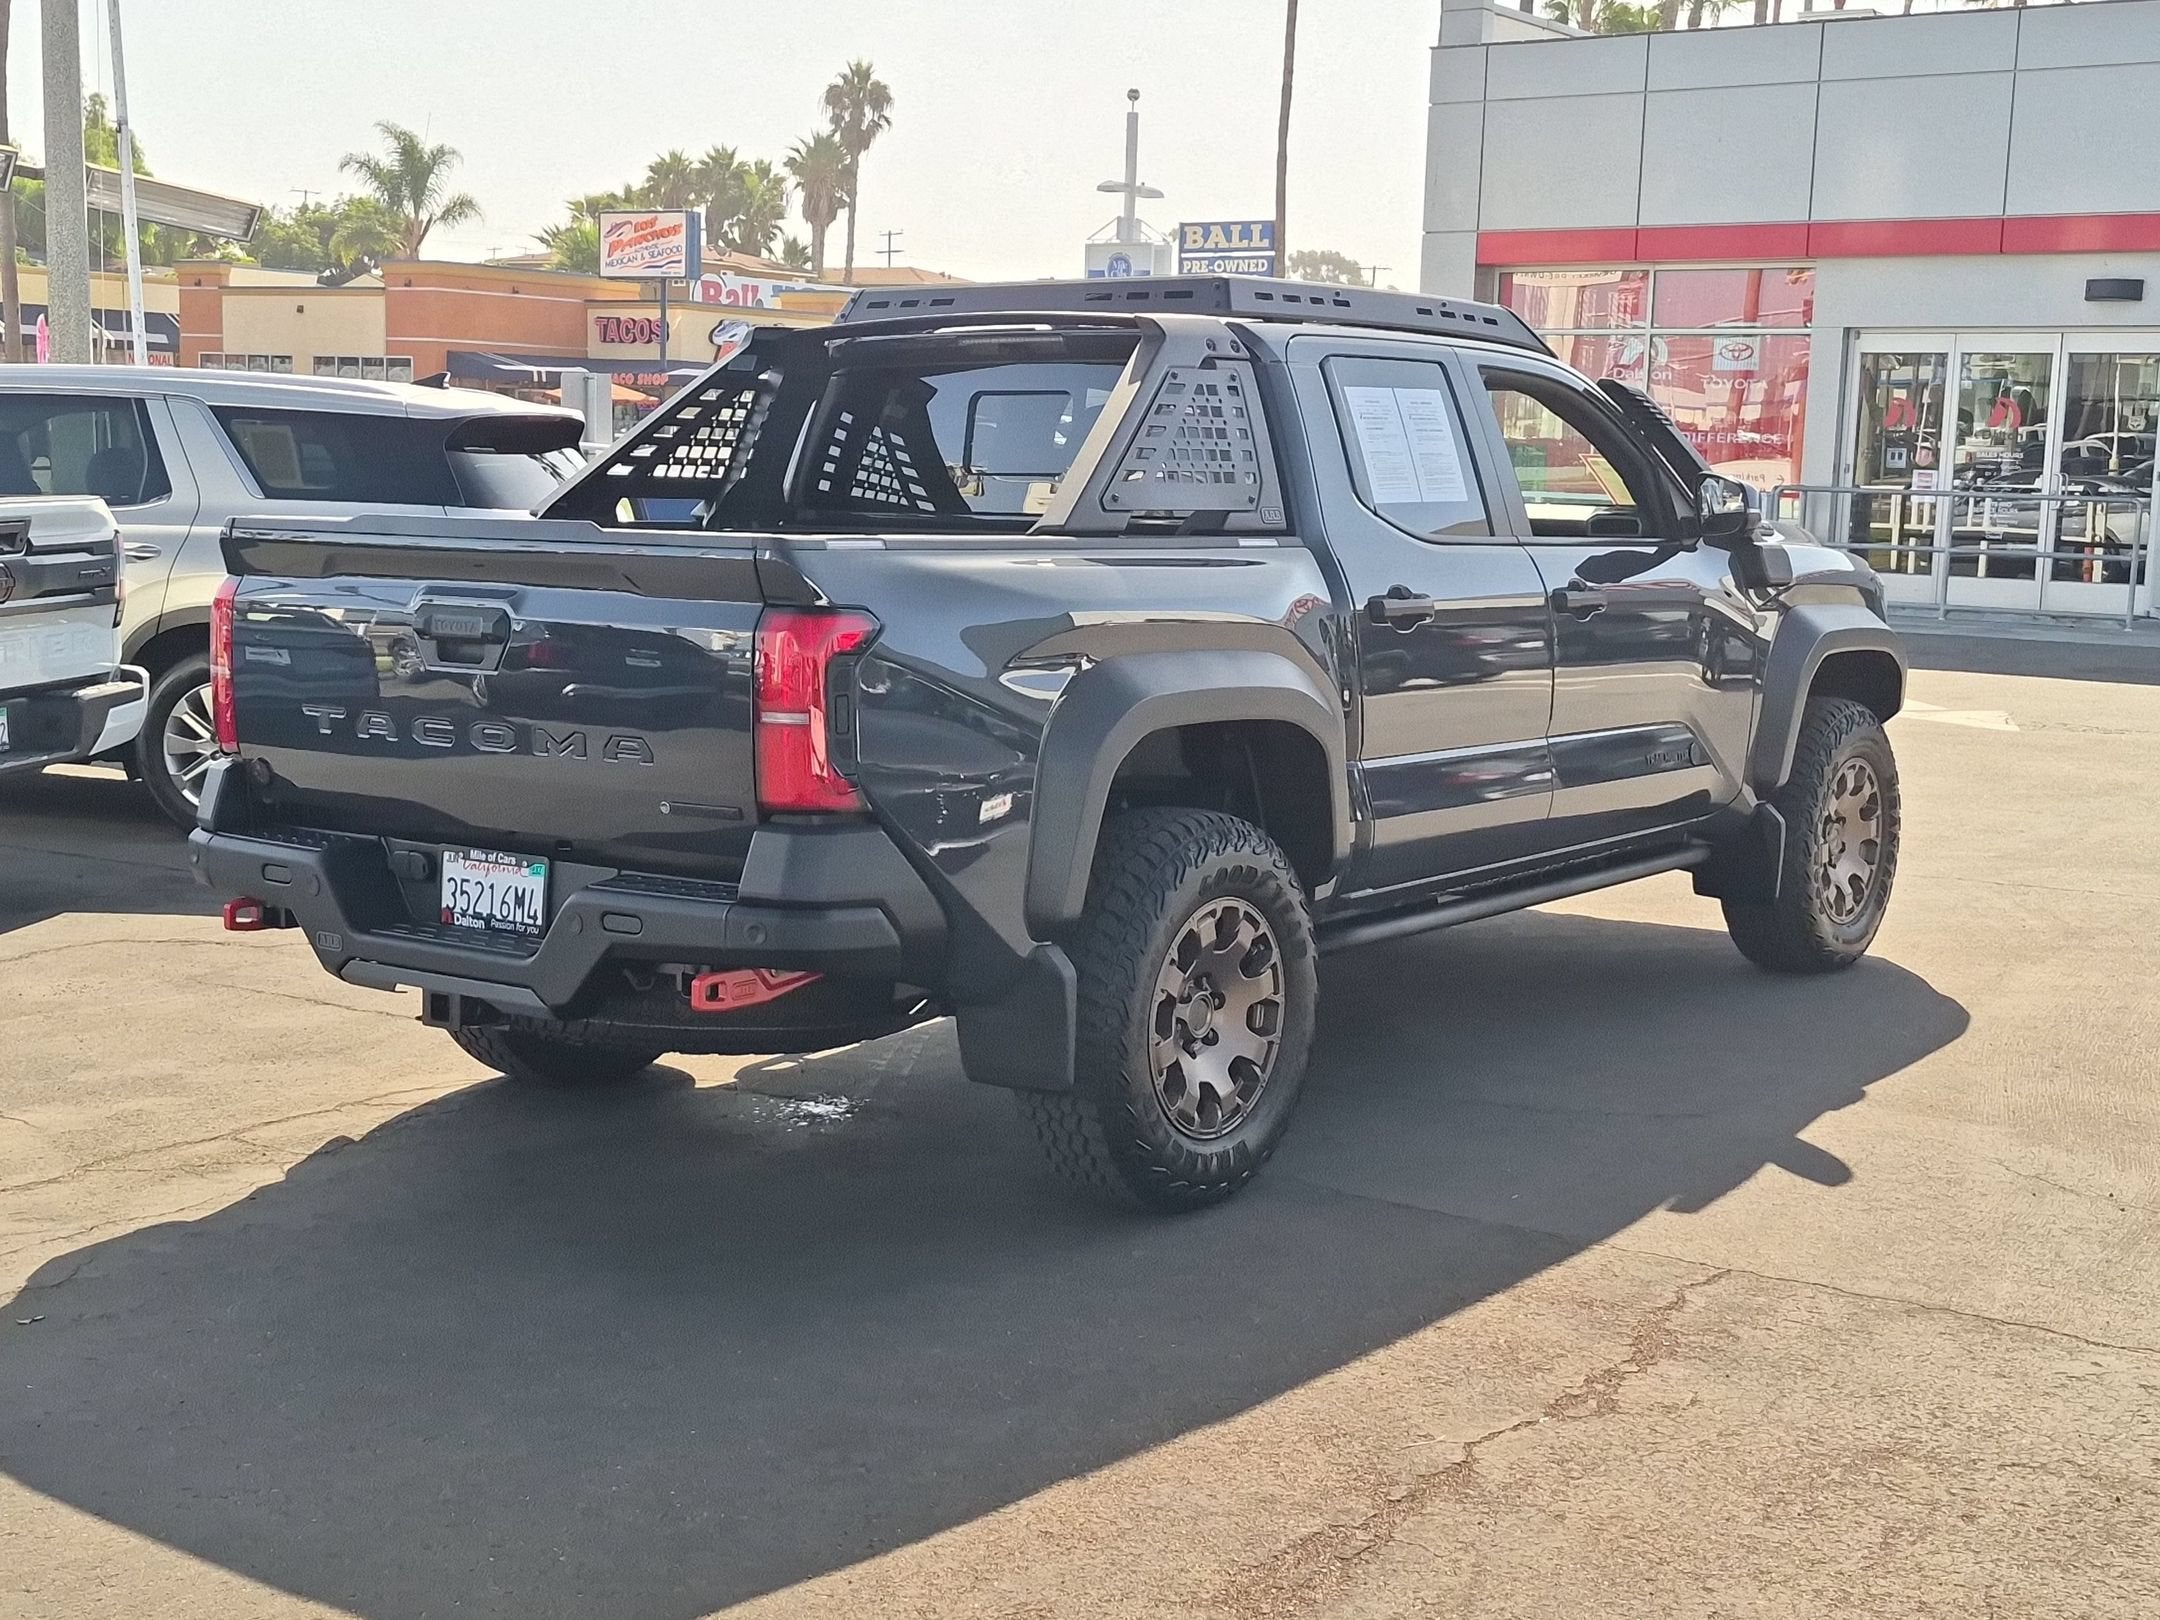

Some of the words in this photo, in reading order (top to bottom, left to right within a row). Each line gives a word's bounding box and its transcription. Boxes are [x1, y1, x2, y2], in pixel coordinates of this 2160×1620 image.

[1183, 224, 1270, 250] BALL
[604, 254, 638, 268] MEXICAN
[640, 253, 646, 261] &
[647, 244, 683, 260] SEAFOOD
[1182, 258, 1268, 274] PRE-OWNED
[700, 279, 759, 306] Ball
[595, 317, 665, 344] TACOS
[612, 373, 634, 385] ACO
[637, 372, 669, 386] SHOP
[1701, 377, 1769, 391] TOYOTA
[301, 703, 654, 766] TACOMA
[470, 849, 486, 861] Mile
[487, 852, 497, 863] of
[497, 853, 516, 865] Cars
[447, 877, 538, 924] 35216M4
[454, 913, 486, 931] Dalton
[490, 918, 515, 932] Passion
[515, 920, 527, 932] for
[526, 925, 540, 935] you
